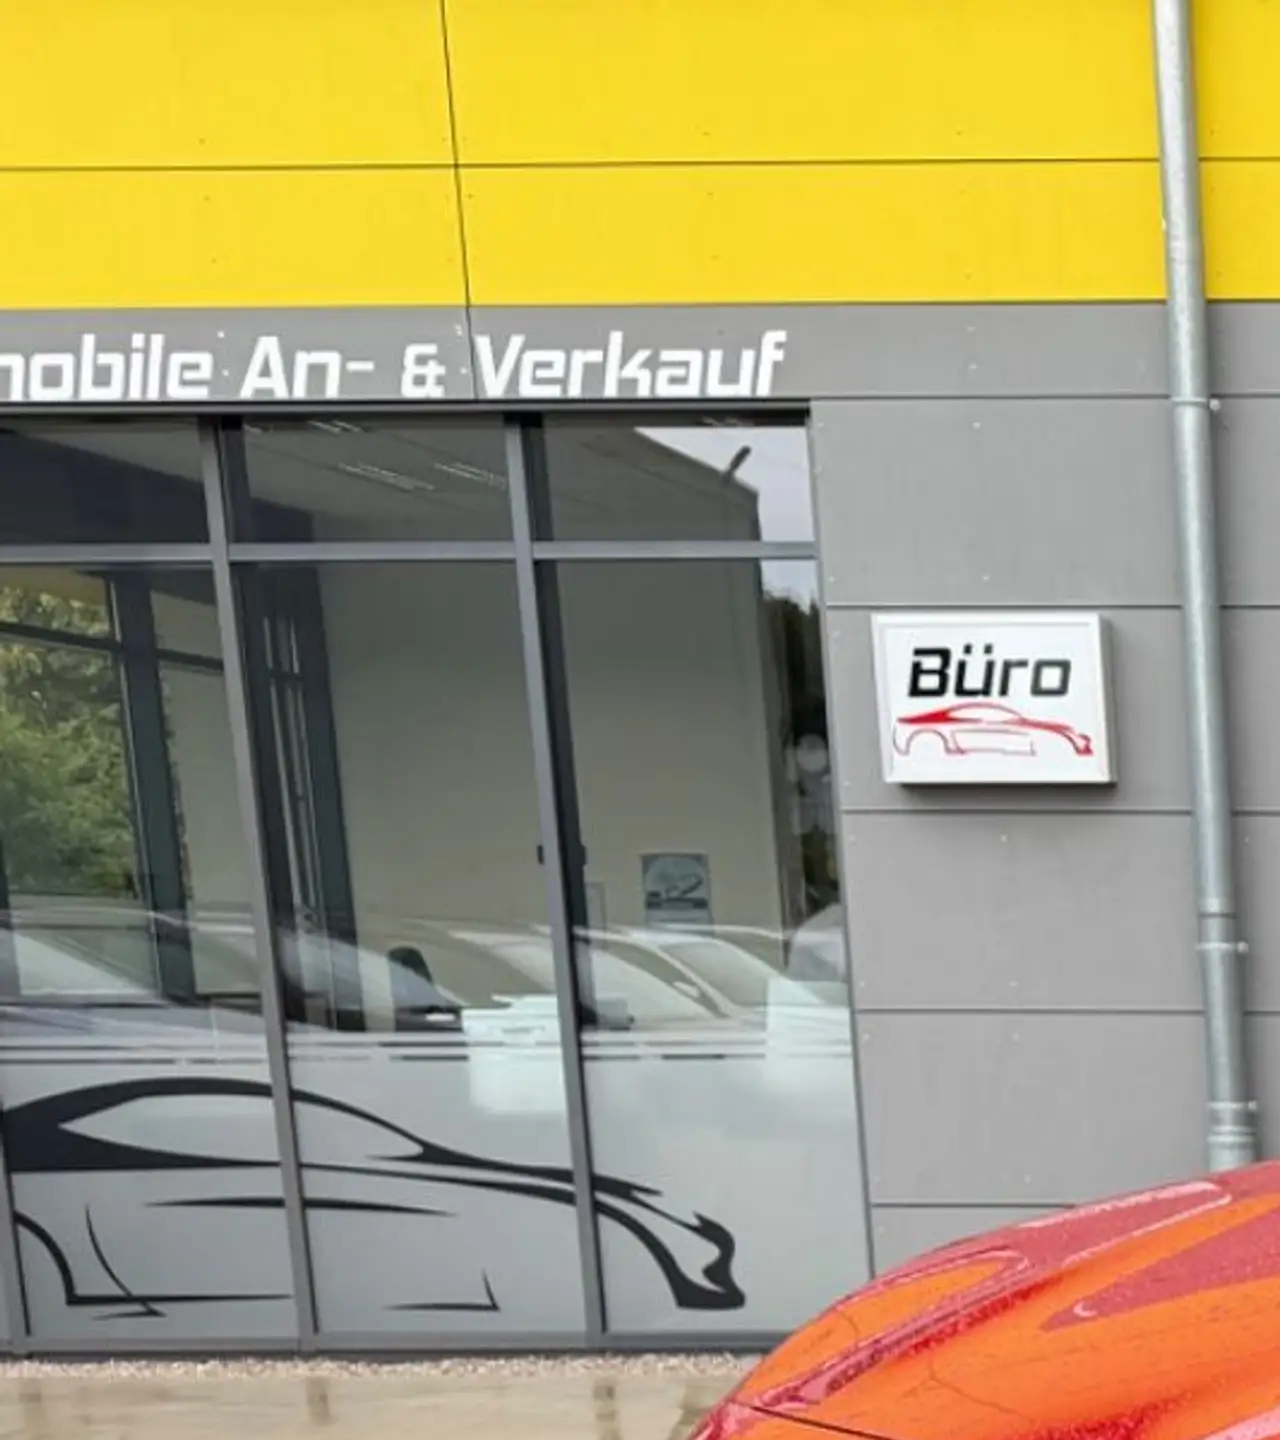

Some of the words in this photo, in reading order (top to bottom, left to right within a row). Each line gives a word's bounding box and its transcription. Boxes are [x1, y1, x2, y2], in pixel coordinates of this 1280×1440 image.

[240, 335, 375, 399] An-
[401, 342, 446, 399] &
[474, 329, 788, 398] Verkauf
[907, 643, 1072, 698] Büro
